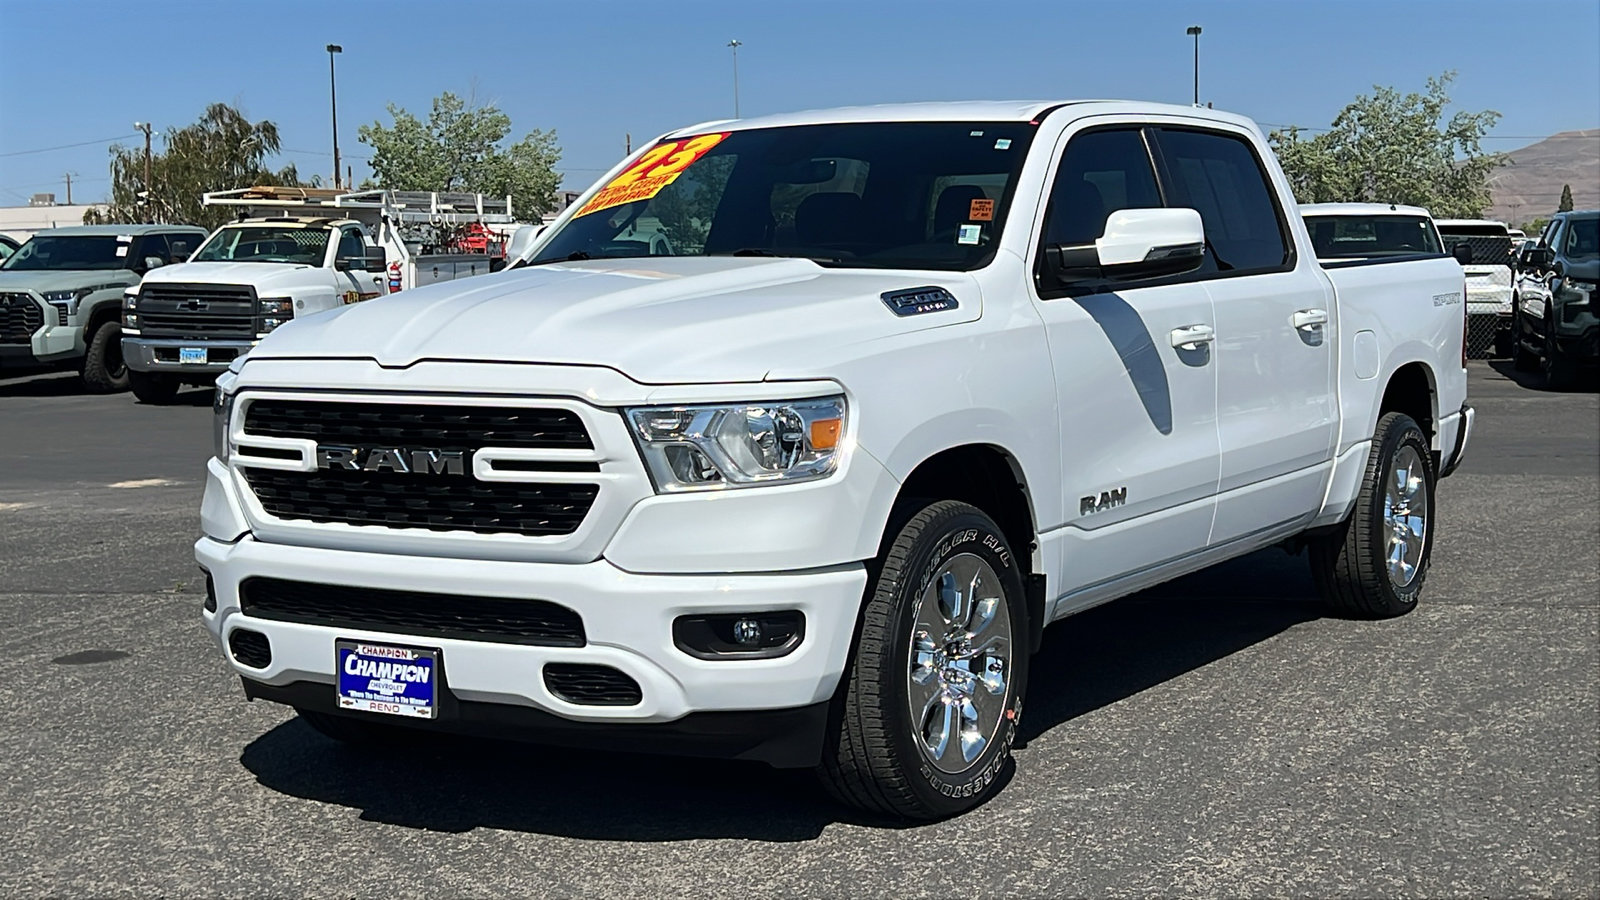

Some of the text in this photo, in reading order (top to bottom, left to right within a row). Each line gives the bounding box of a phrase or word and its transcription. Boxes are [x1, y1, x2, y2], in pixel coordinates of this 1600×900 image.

[606, 133, 723, 190] 23
[891, 290, 945, 308] 1500
[1432, 292, 1461, 307] SPORT
[317, 443, 465, 476] RAM
[1080, 486, 1127, 516] RAM
[983, 534, 1010, 568] H/L
[362, 646, 408, 659] CHAMPION
[344, 653, 430, 684] CHAMPION
[370, 681, 404, 692] CHEVROLET
[369, 702, 400, 713] RENO
